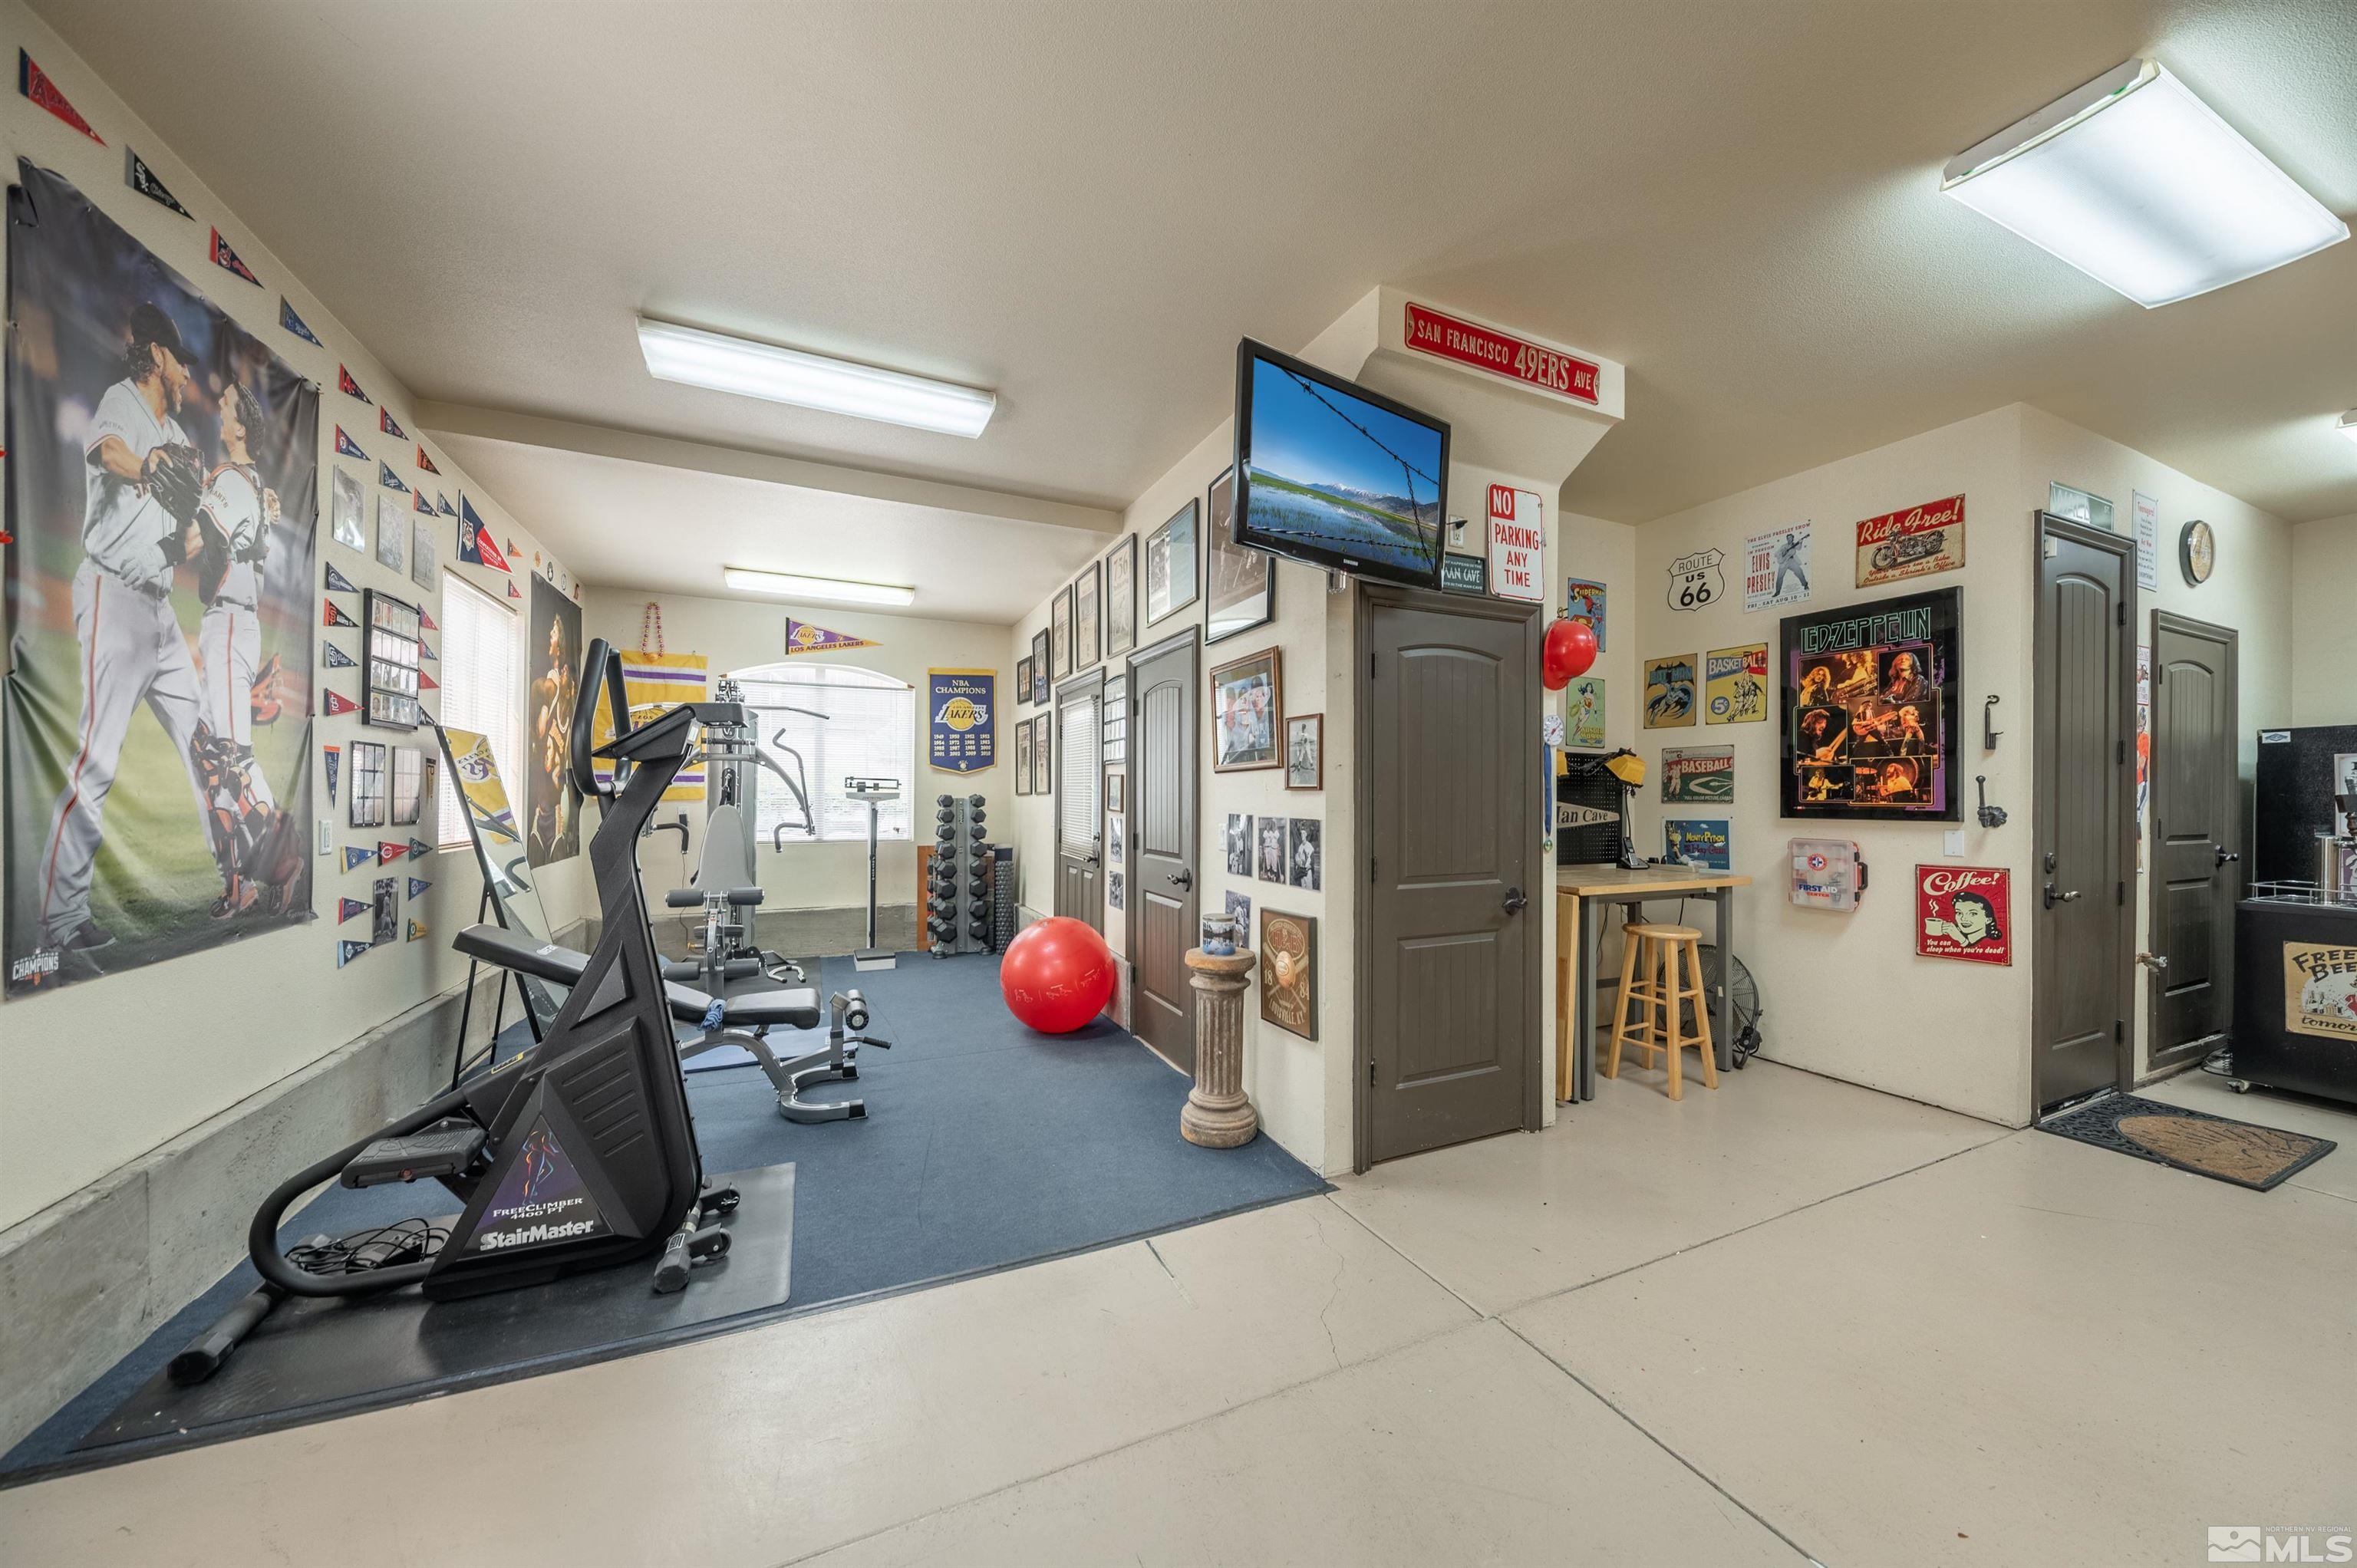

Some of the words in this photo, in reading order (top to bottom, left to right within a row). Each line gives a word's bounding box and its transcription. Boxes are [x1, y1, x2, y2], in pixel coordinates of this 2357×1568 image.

[1418, 319, 1442, 343] SAN
[1446, 328, 1509, 364] FRANCISCO
[1514, 345, 1570, 390] 49ERS
[1574, 370, 1592, 390] AVE
[1492, 489, 1512, 516] NO
[1772, 527, 1794, 536] PRESLEY
[1795, 522, 1811, 531] SHOW
[1860, 516, 1902, 543] Ride
[1904, 499, 1961, 532] Free!
[1495, 522, 1539, 551] PARKING
[1114, 550, 1128, 582] 756
[1506, 551, 1528, 568] ANY
[1678, 555, 1713, 572] ROUTE
[1752, 552, 1770, 573] ELVIS
[1464, 569, 1480, 583] CAVE
[1505, 568, 1531, 588] TIME
[1686, 572, 1705, 583] US
[1747, 572, 1775, 595] PRESLEY
[1680, 582, 1711, 607] 66
[839, 640, 864, 648] LAKERS
[938, 705, 987, 723] LAKERS
[1681, 758, 1729, 773] BASEBALL
[1557, 805, 1578, 823] an
[1582, 809, 1608, 822] Cave
[1686, 832, 1704, 842] MONTY
[1704, 831, 1726, 843] PYTHON
[1923, 871, 2000, 896] Coffee!
[12, 956, 59, 980] CHAMPIONS
[2292, 949, 2357, 973] FREE
[1264, 969, 1273, 986] 18
[2308, 961, 2357, 983] BEE
[1300, 981, 1310, 1000] 84
[2302, 1016, 2357, 1031] tomor
[493, 1197, 584, 1217] FREECLIMBER
[510, 1211, 543, 1220] 4400
[547, 1206, 565, 1214] PT
[480, 1220, 594, 1251] StairMaster
